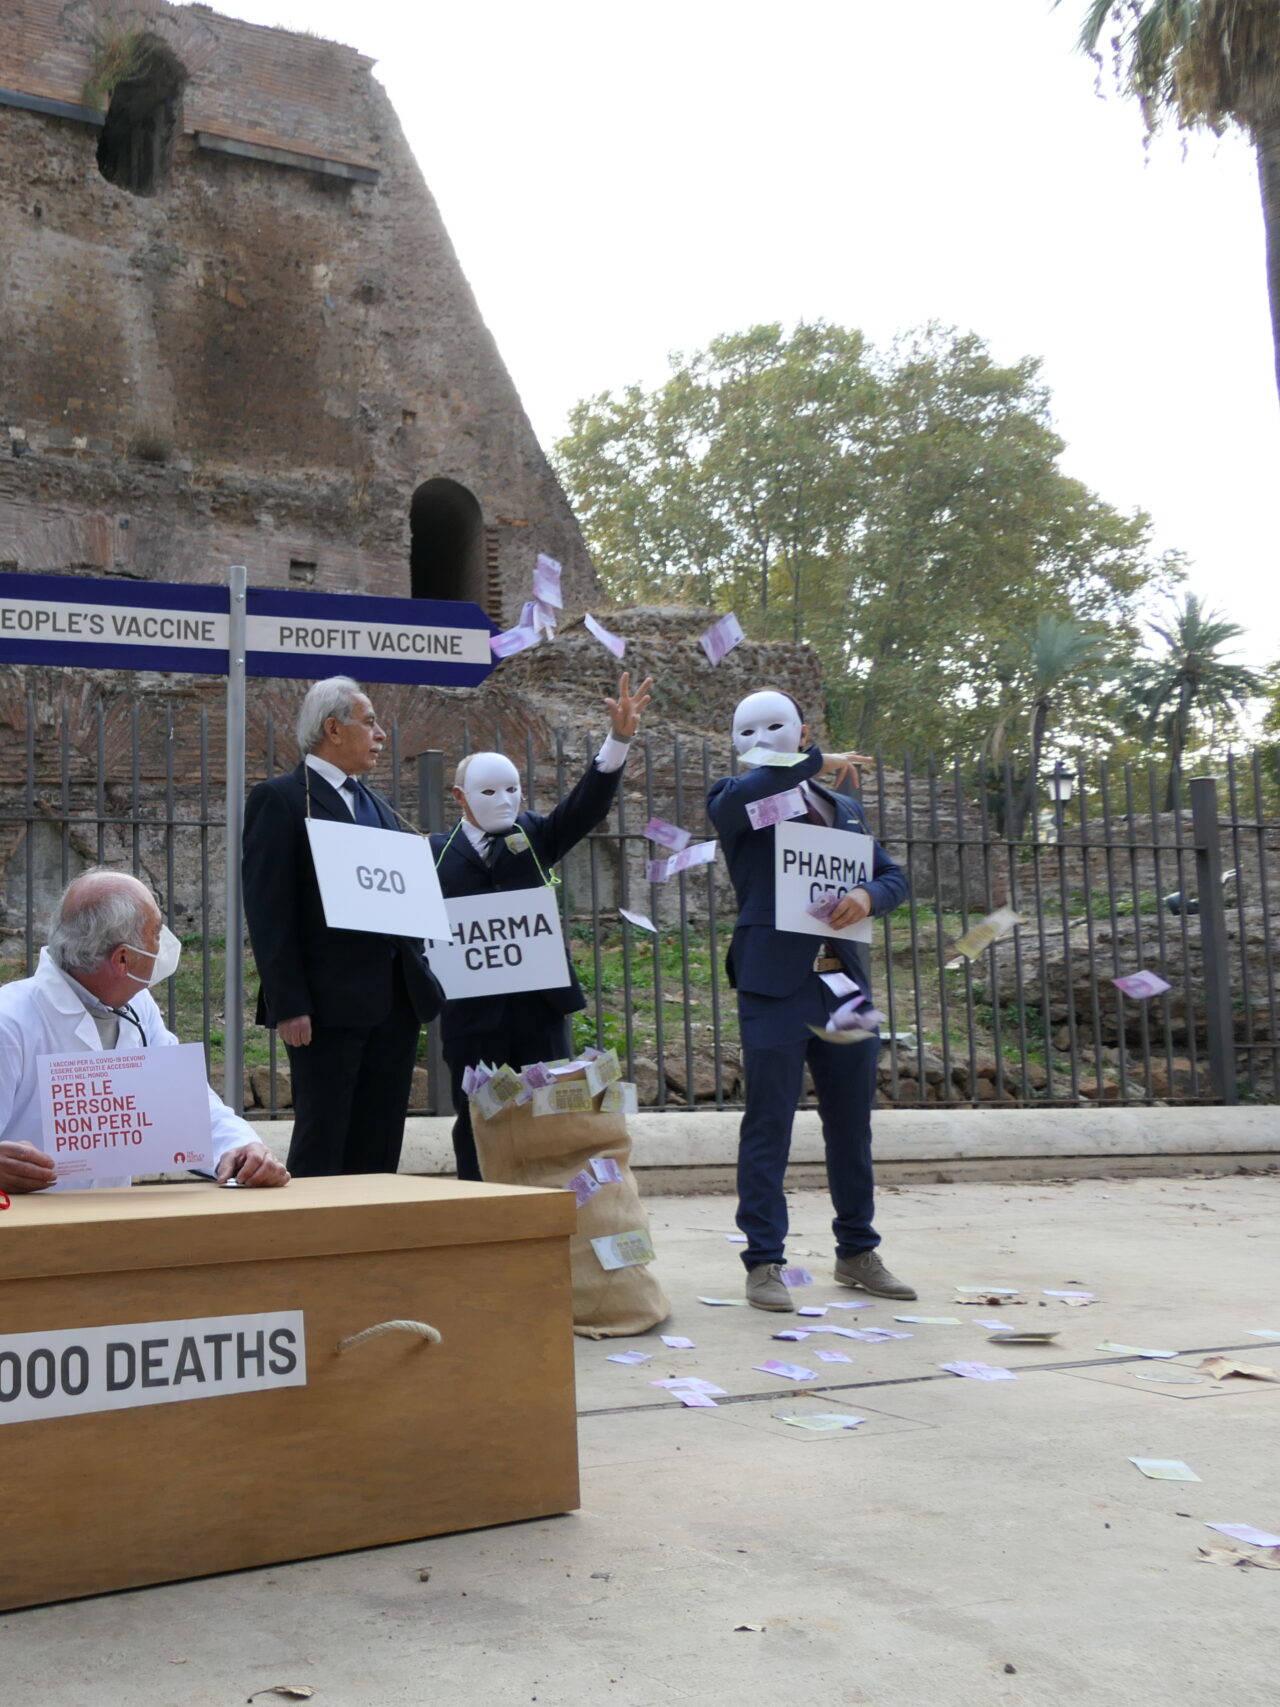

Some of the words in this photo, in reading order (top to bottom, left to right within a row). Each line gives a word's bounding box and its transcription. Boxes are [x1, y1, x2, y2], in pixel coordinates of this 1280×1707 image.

[112, 615, 215, 641] VACCINE
[279, 626, 360, 650] PROFIT
[367, 631, 463, 655] VACCINE
[356, 865, 406, 895] G20
[784, 849, 867, 885] PHARMA
[429, 912, 553, 949] HARMA
[464, 943, 523, 971] CEO
[51, 1066, 74, 1075] ESSERE
[74, 1064, 101, 1073] GRATUITI
[107, 1061, 142, 1070] ACCESSIBILI
[51, 1082, 87, 1099] PER
[91, 1080, 114, 1096] LE
[53, 1095, 137, 1117] PERSONE
[54, 1116, 93, 1135] NON
[97, 1113, 132, 1131] PER
[137, 1111, 153, 1127] IL
[56, 1130, 143, 1152] PROFITTO
[105, 1328, 298, 1392] DEATHS
